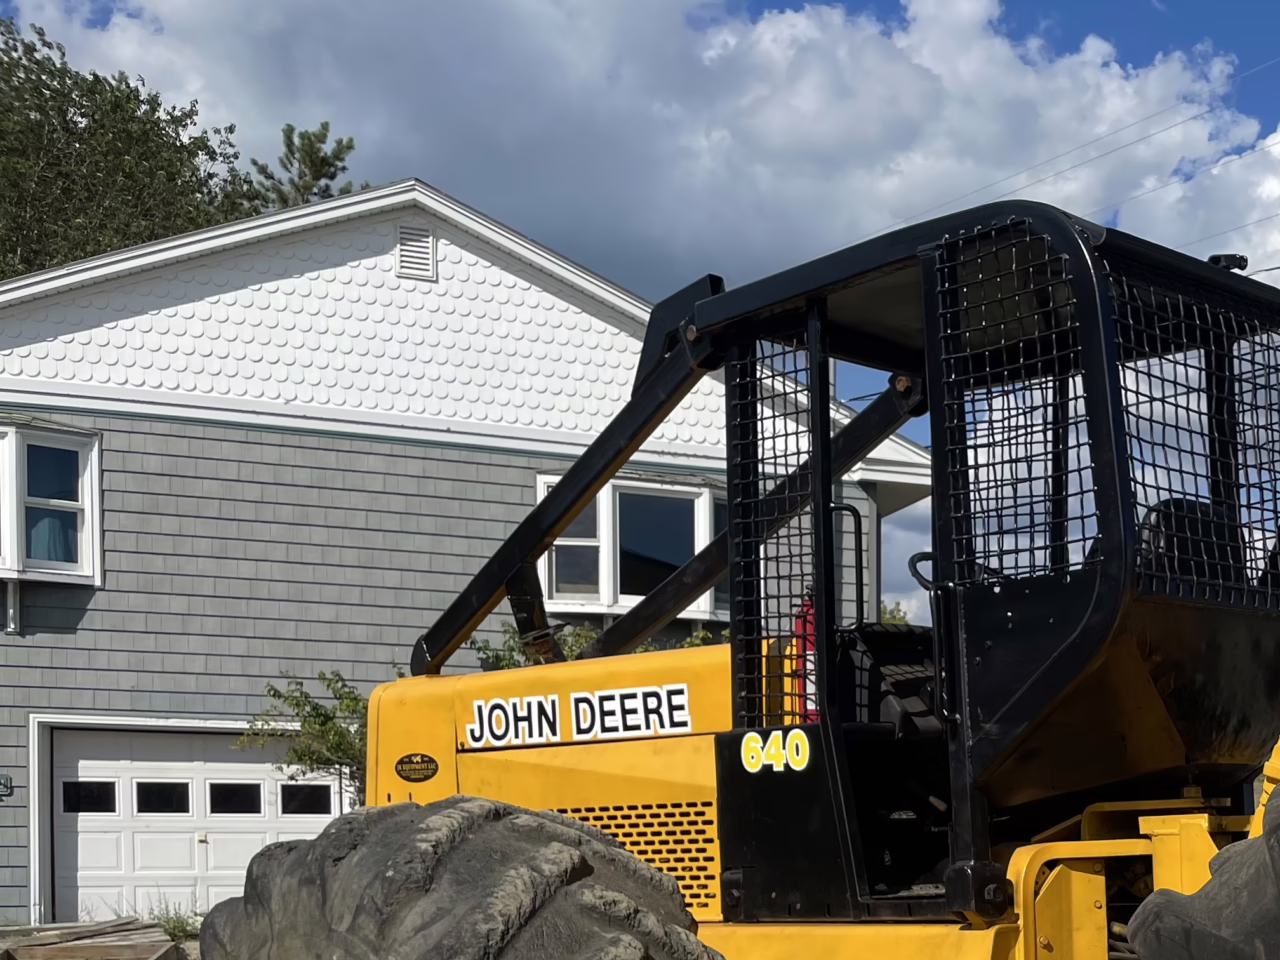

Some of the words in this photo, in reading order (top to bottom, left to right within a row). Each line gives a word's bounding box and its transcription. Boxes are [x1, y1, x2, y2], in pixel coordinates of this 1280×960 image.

[468, 697, 559, 745] JOHN
[572, 686, 690, 737] DEERE
[742, 729, 809, 773] 640
